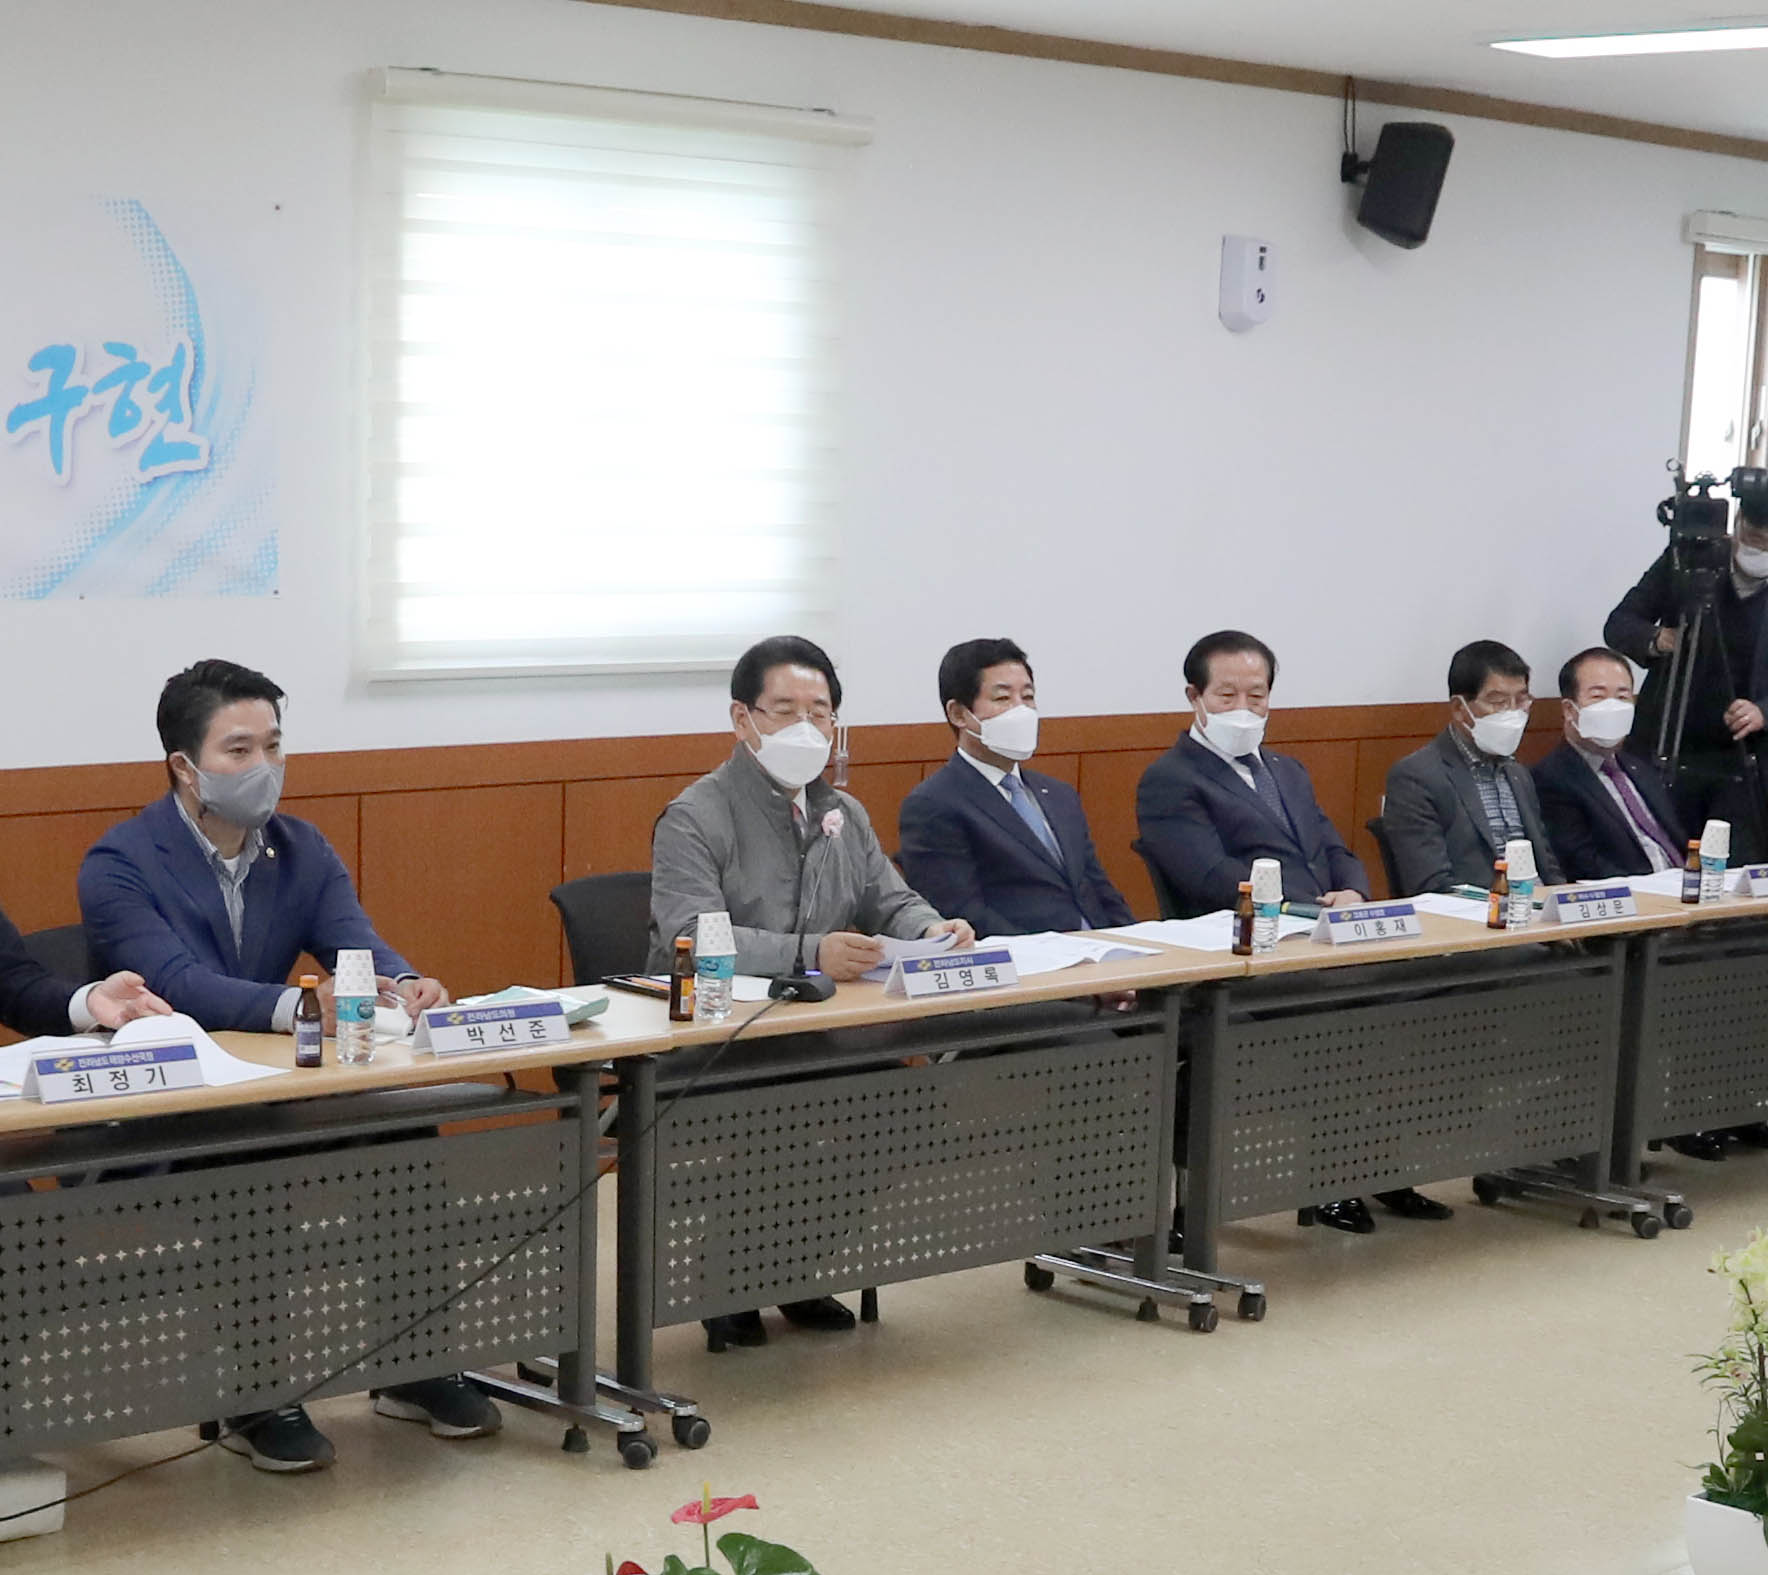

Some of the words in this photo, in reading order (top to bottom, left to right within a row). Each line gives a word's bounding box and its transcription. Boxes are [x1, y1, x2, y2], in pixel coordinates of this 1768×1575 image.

[8, 338, 208, 474] 구현
[933, 966, 1000, 990] 김영록
[466, 1019, 547, 1046] 박선준
[72, 1065, 167, 1094] 최정기
